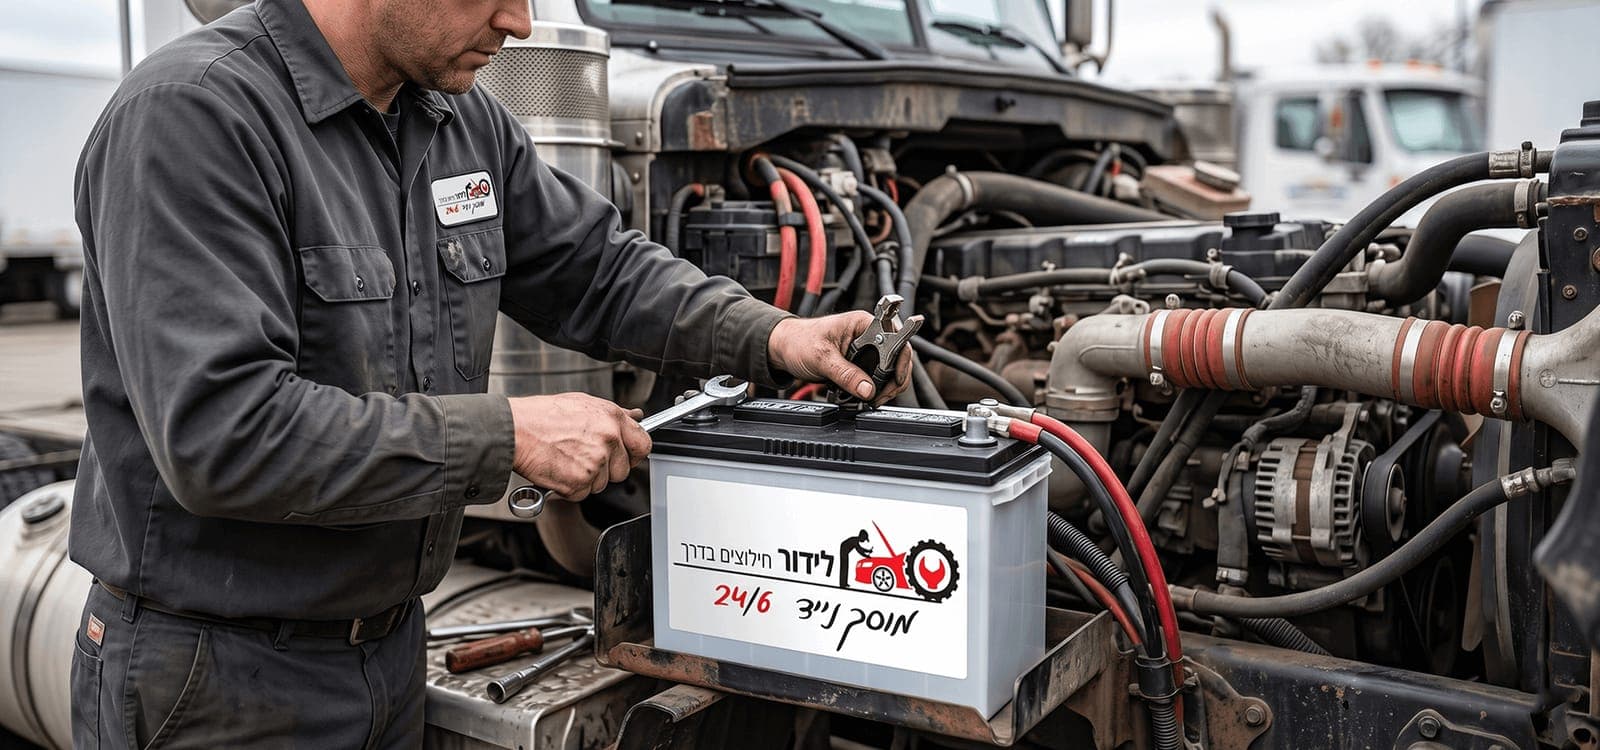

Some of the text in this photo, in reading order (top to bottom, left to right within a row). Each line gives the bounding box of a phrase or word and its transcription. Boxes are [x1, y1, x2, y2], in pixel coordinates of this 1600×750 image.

[681, 542, 835, 578] לידור חילוצים בדרך
[713, 584, 919, 652] מוסך נייד 24/6
